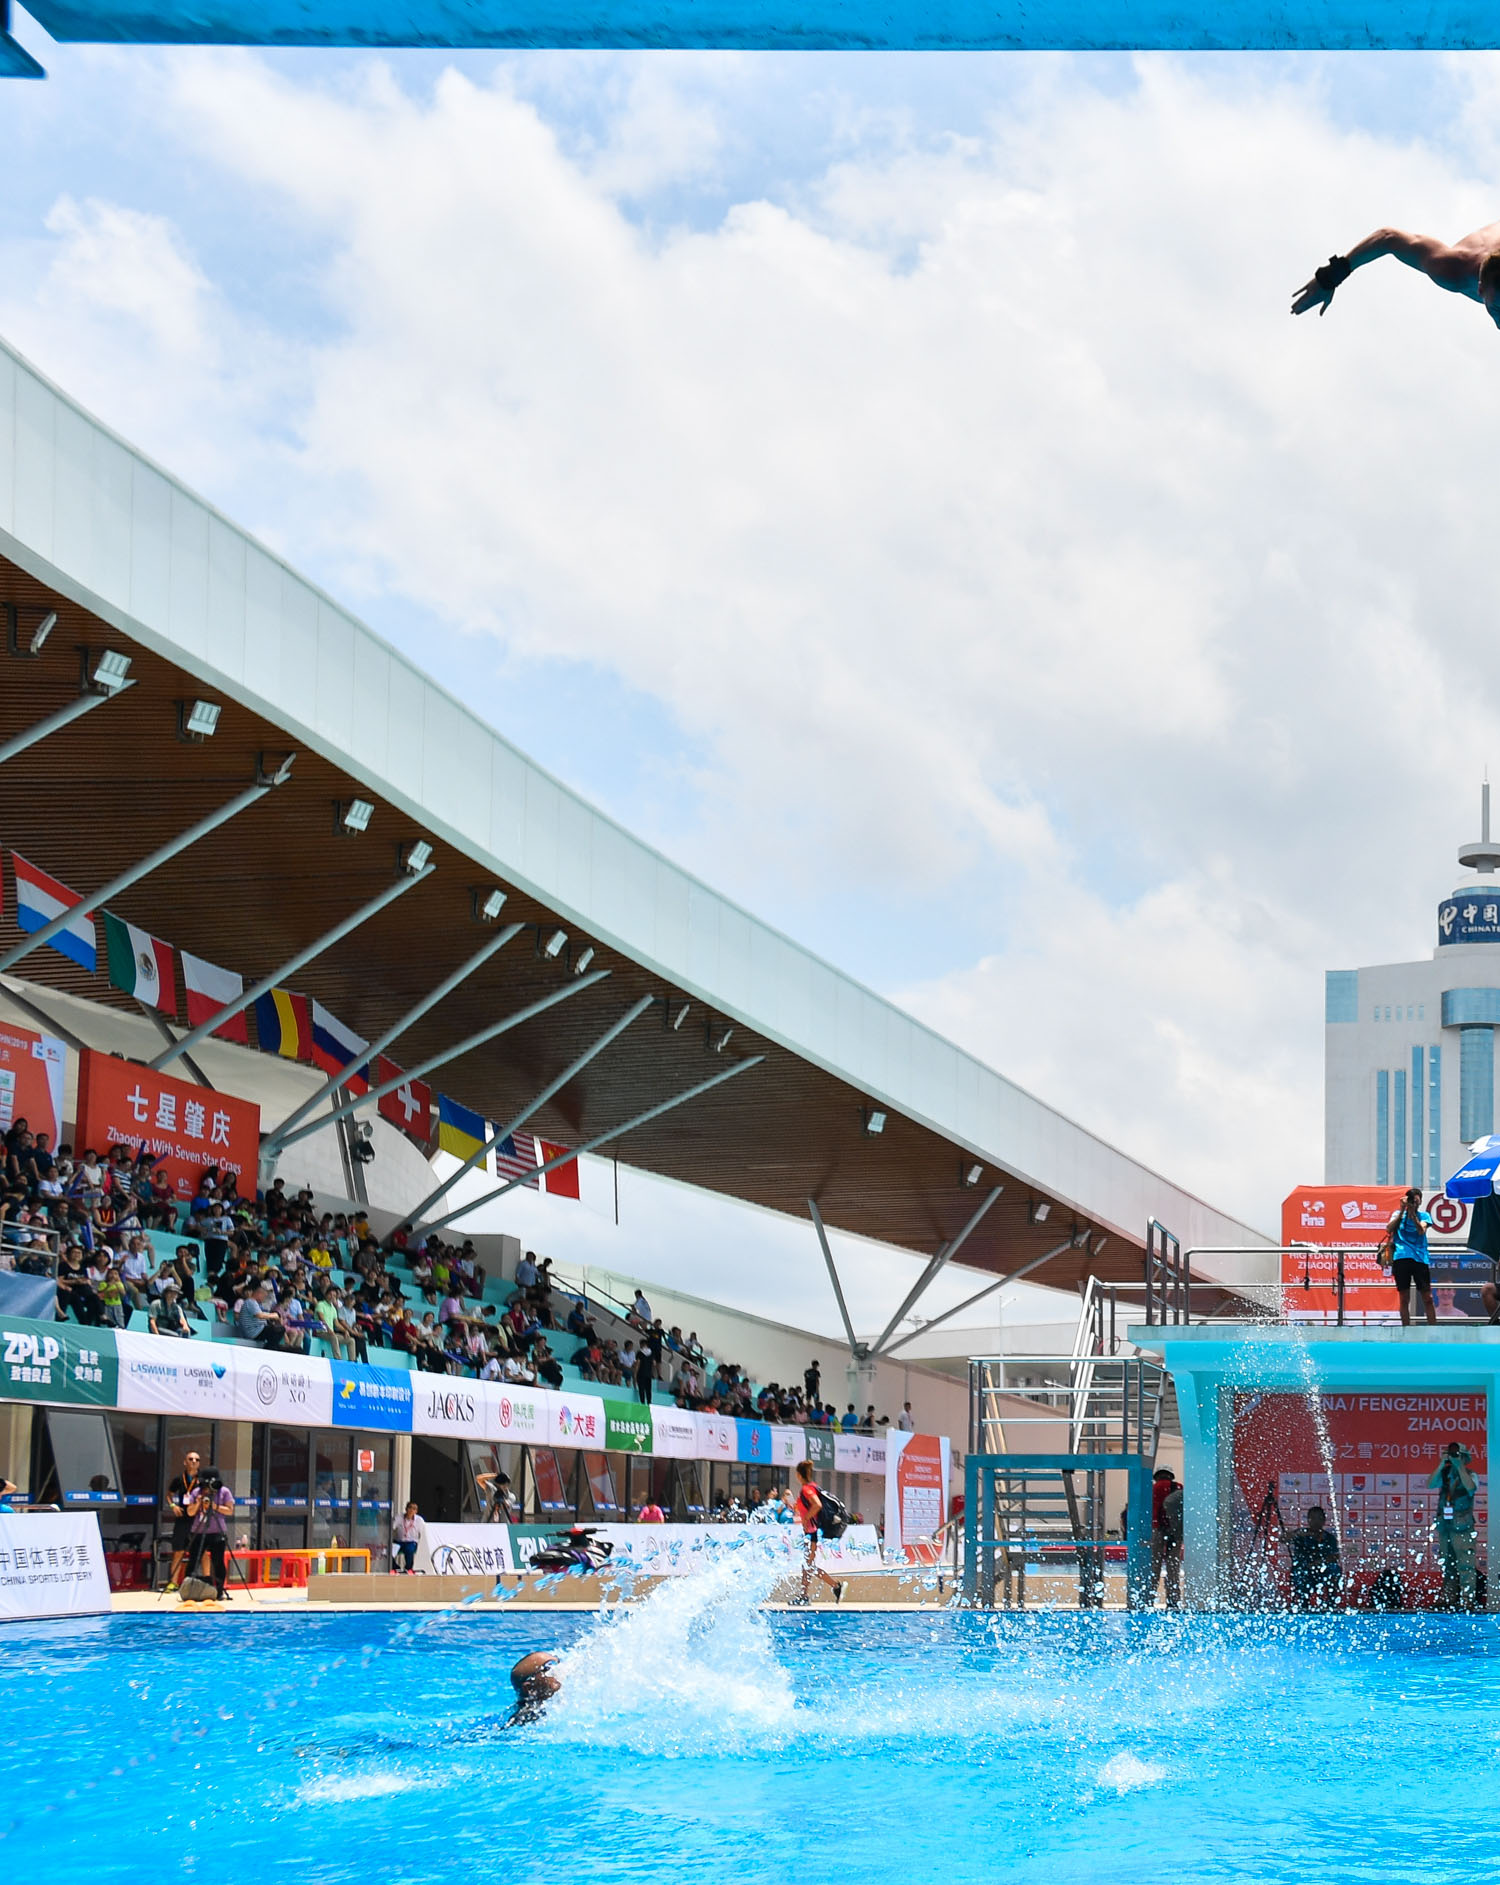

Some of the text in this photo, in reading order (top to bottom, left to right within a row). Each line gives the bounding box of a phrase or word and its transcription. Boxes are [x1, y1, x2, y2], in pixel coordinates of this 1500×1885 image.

[127, 1085, 231, 1148] 七星肇庆
[152, 1138, 174, 1155] With
[175, 1145, 200, 1163] Seven
[202, 1151, 218, 1168] Star
[3, 1332, 59, 1366] ZPLP
[427, 1391, 475, 1422] JACKS
[1360, 1397, 1471, 1412] FENGZHIXUE
[574, 1414, 595, 1438] 大麦
[0, 1545, 90, 1571] 中国体育彩票
[0, 1571, 92, 1586] CHINA SPORTS LOTTERY
